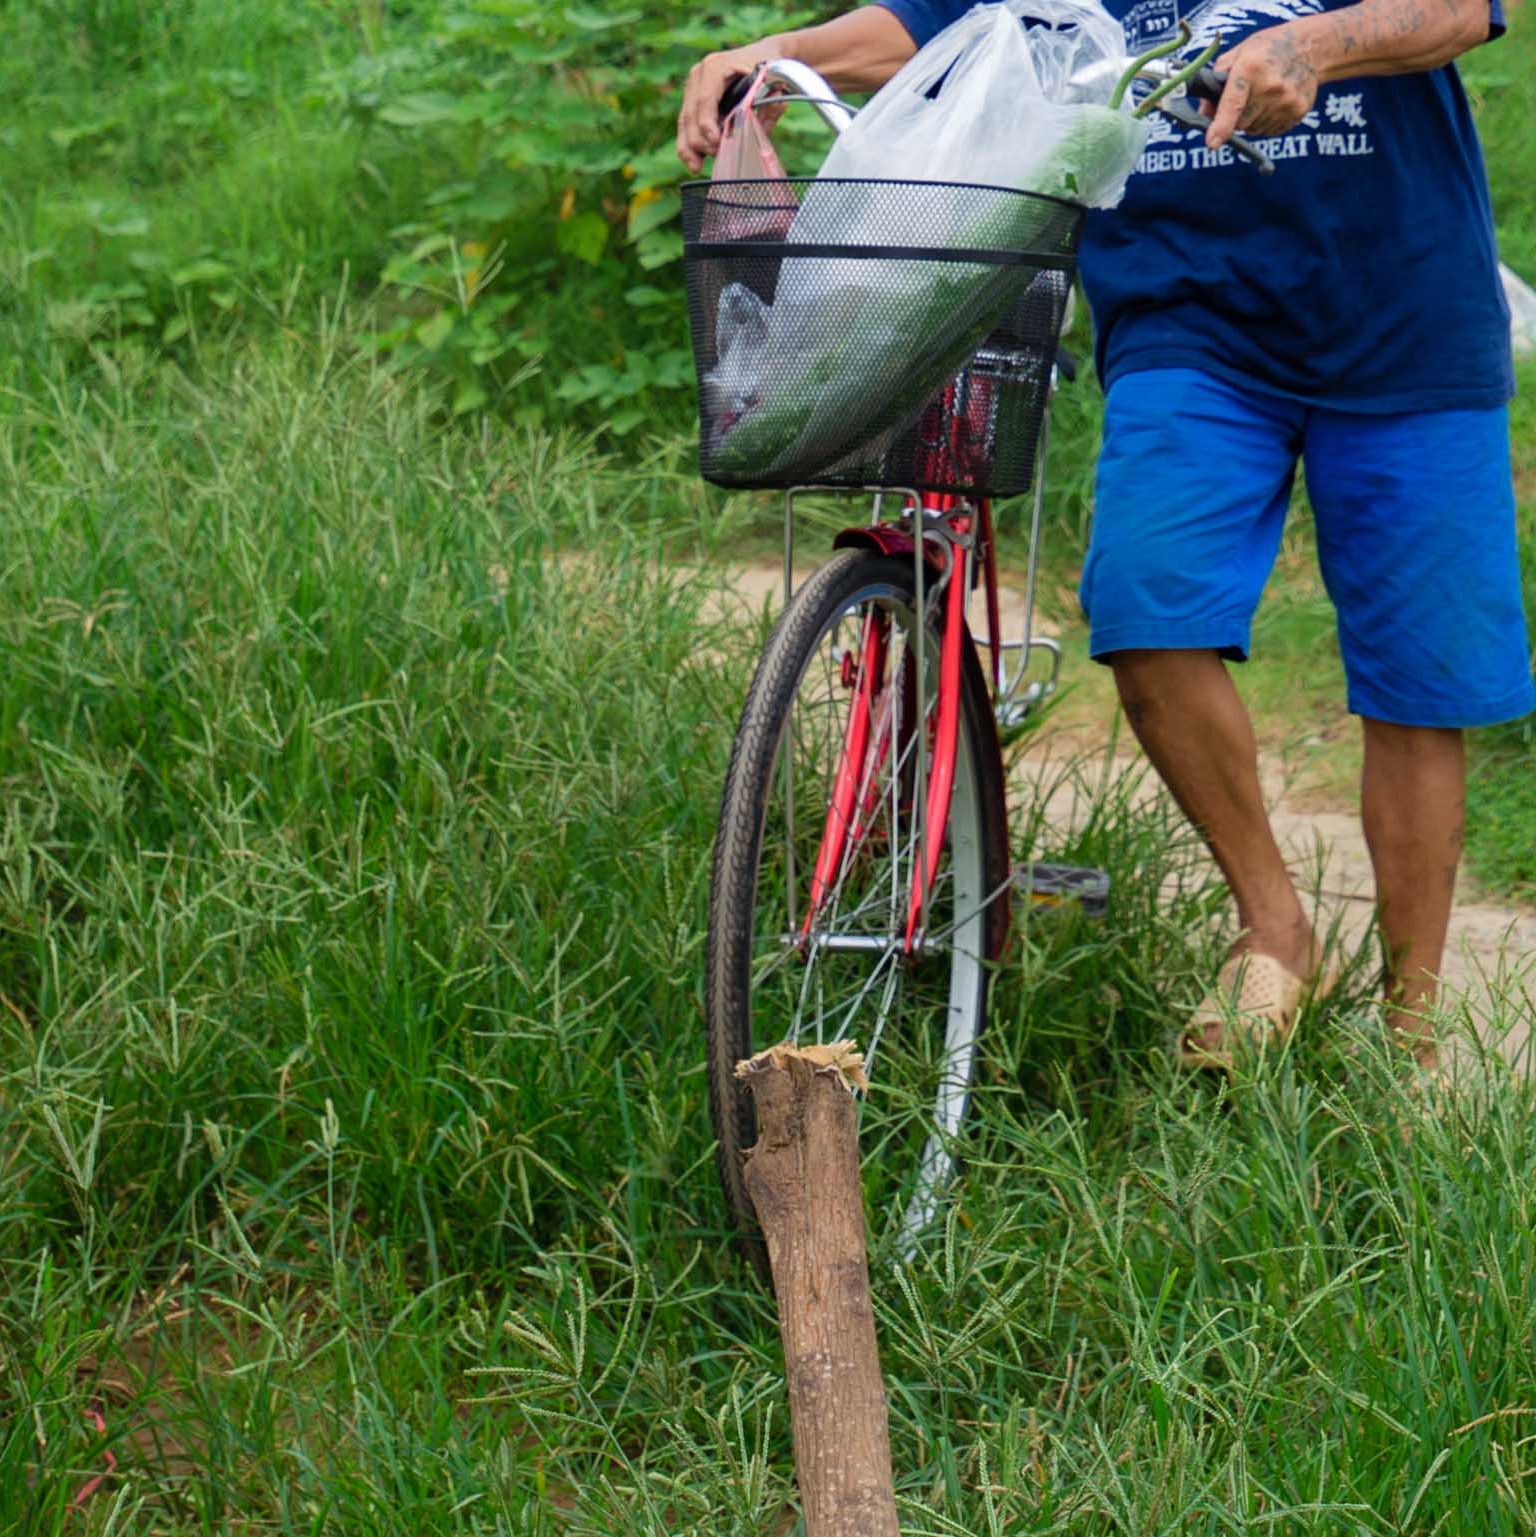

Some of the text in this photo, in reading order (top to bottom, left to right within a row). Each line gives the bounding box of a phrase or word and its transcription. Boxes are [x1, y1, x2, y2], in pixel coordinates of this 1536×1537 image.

[1130, 132, 1375, 175] MBED THE REAT WALL
